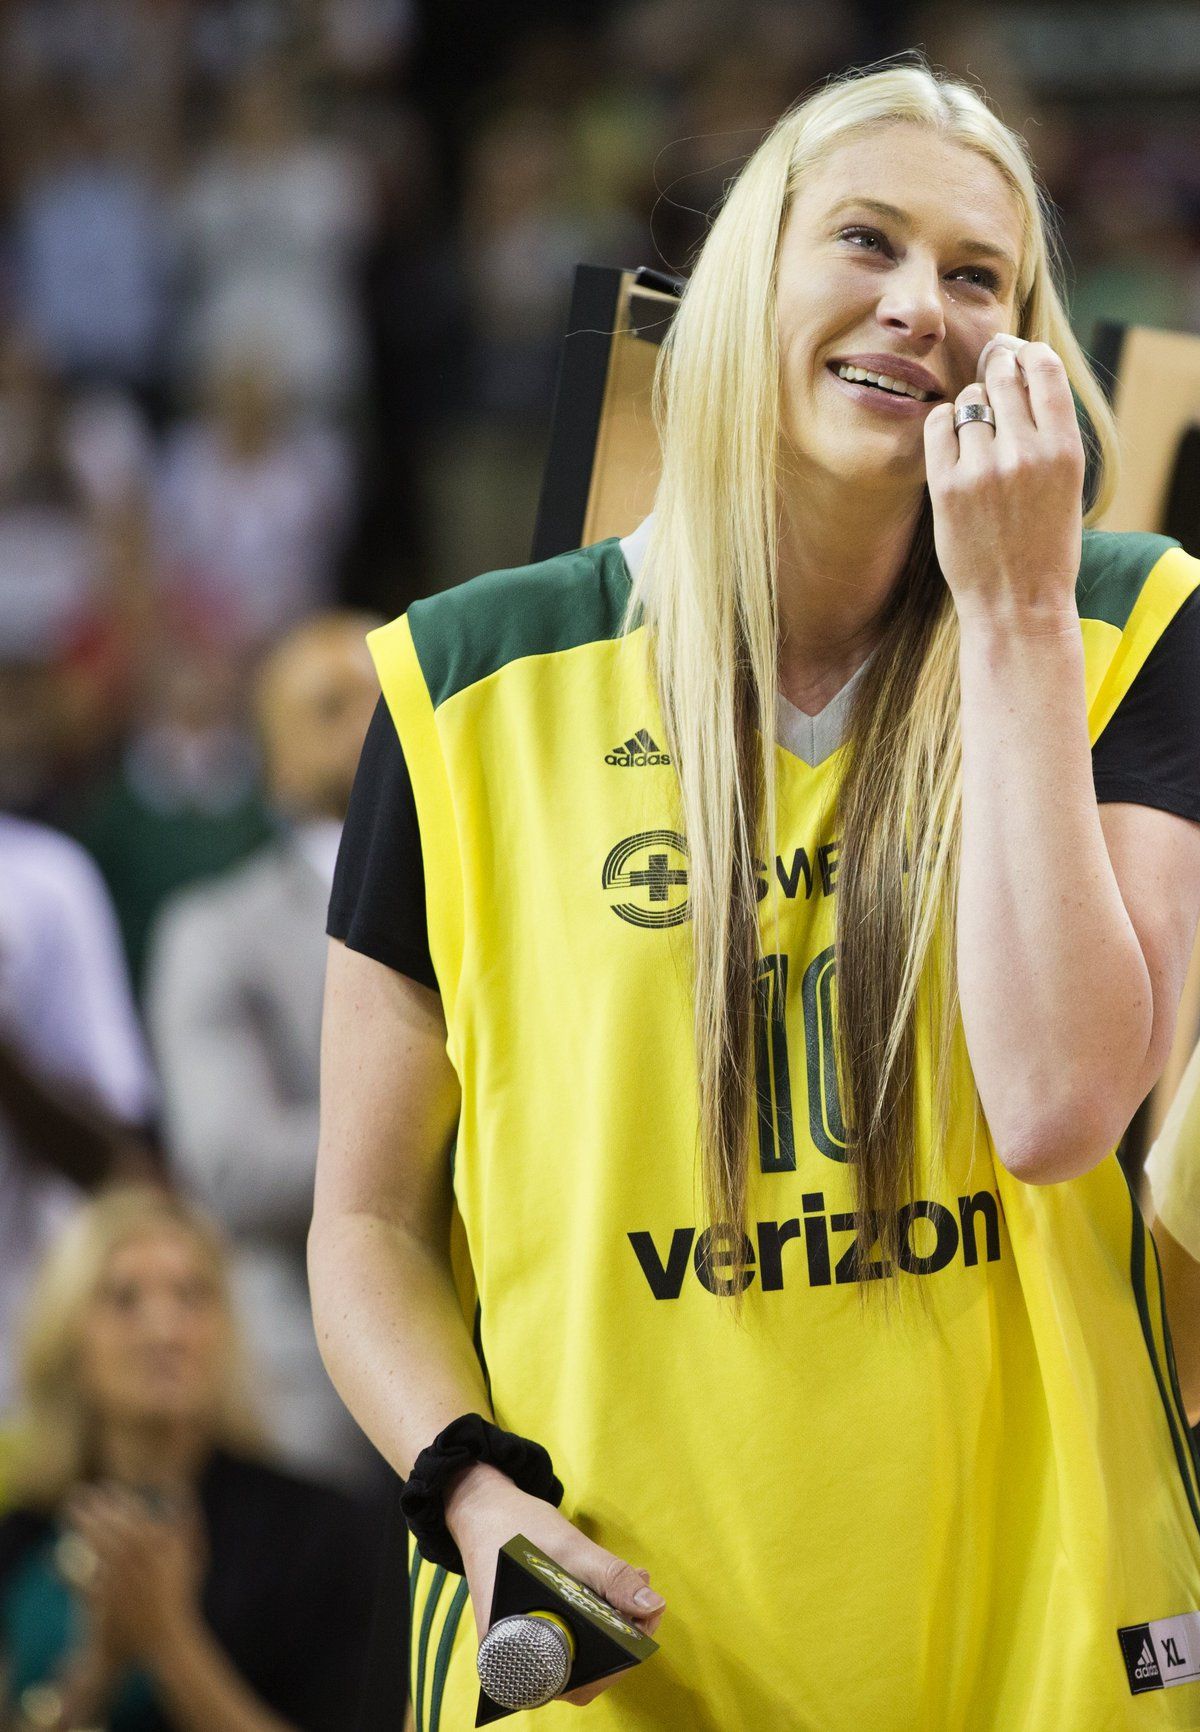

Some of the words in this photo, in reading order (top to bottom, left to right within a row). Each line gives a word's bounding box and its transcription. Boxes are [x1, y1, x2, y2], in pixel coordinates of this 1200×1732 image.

[604, 752, 671, 768] adidas
[627, 1190, 1001, 1300] verizon
[1161, 1637, 1186, 1668] XL
